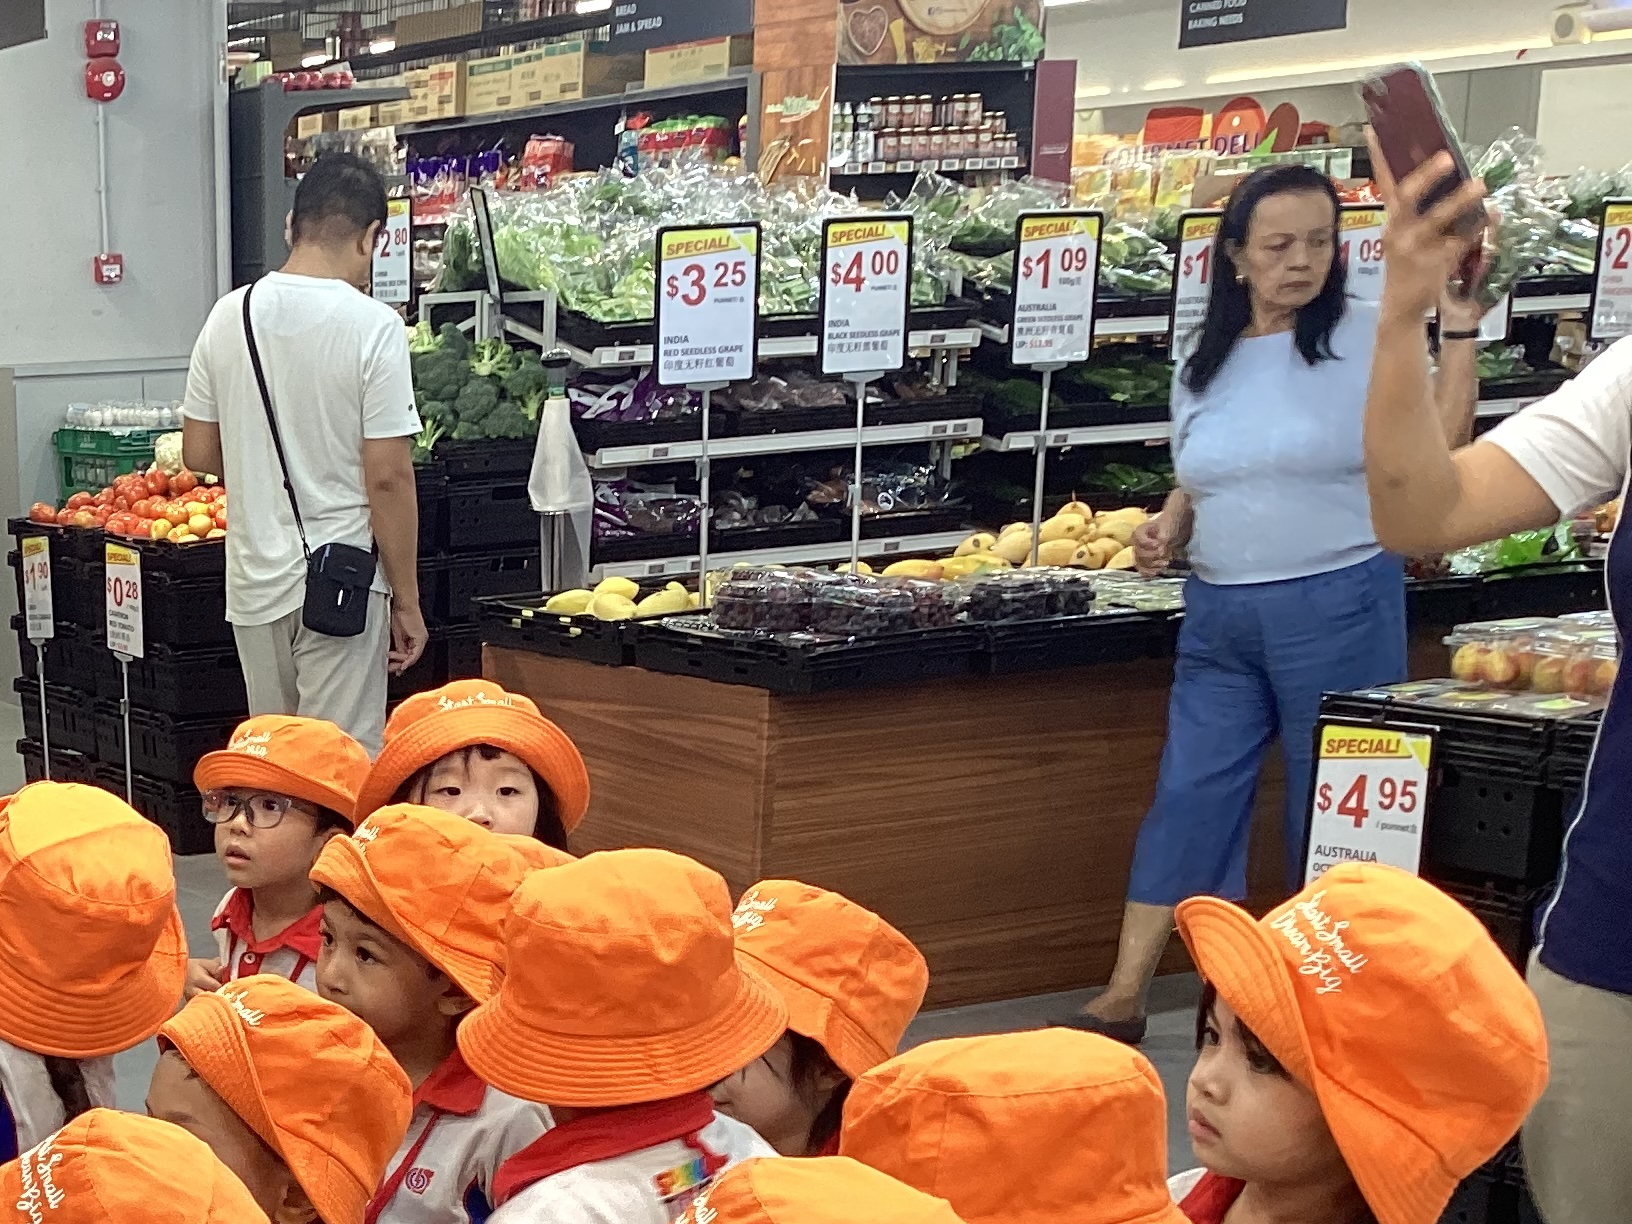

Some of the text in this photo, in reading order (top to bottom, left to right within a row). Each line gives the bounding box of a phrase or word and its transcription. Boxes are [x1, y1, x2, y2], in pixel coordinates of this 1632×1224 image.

[615, 22, 630, 35] JAM
[637, 16, 663, 31] SPREAD
[1214, 131, 1262, 156] DELI
[394, 227, 408, 246] 80
[831, 224, 886, 243] SPECIAL!
[1023, 219, 1077, 238] SPECIAL!
[666, 236, 731, 256] SPECIAL!
[1018, 303, 1057, 312] AUSTRALIA
[828, 319, 850, 328] INDIA
[664, 335, 689, 345] INDIA
[828, 329, 900, 340] BLACK SEEDLESS GRAPE
[664, 344, 744, 357] RED SEEDLESS GRAPE
[1325, 738, 1401, 754] SPECIAL!
[1314, 845, 1377, 863] AUSTRALIA
[1315, 920, 1369, 974] Small
[1299, 948, 1343, 994] Big
